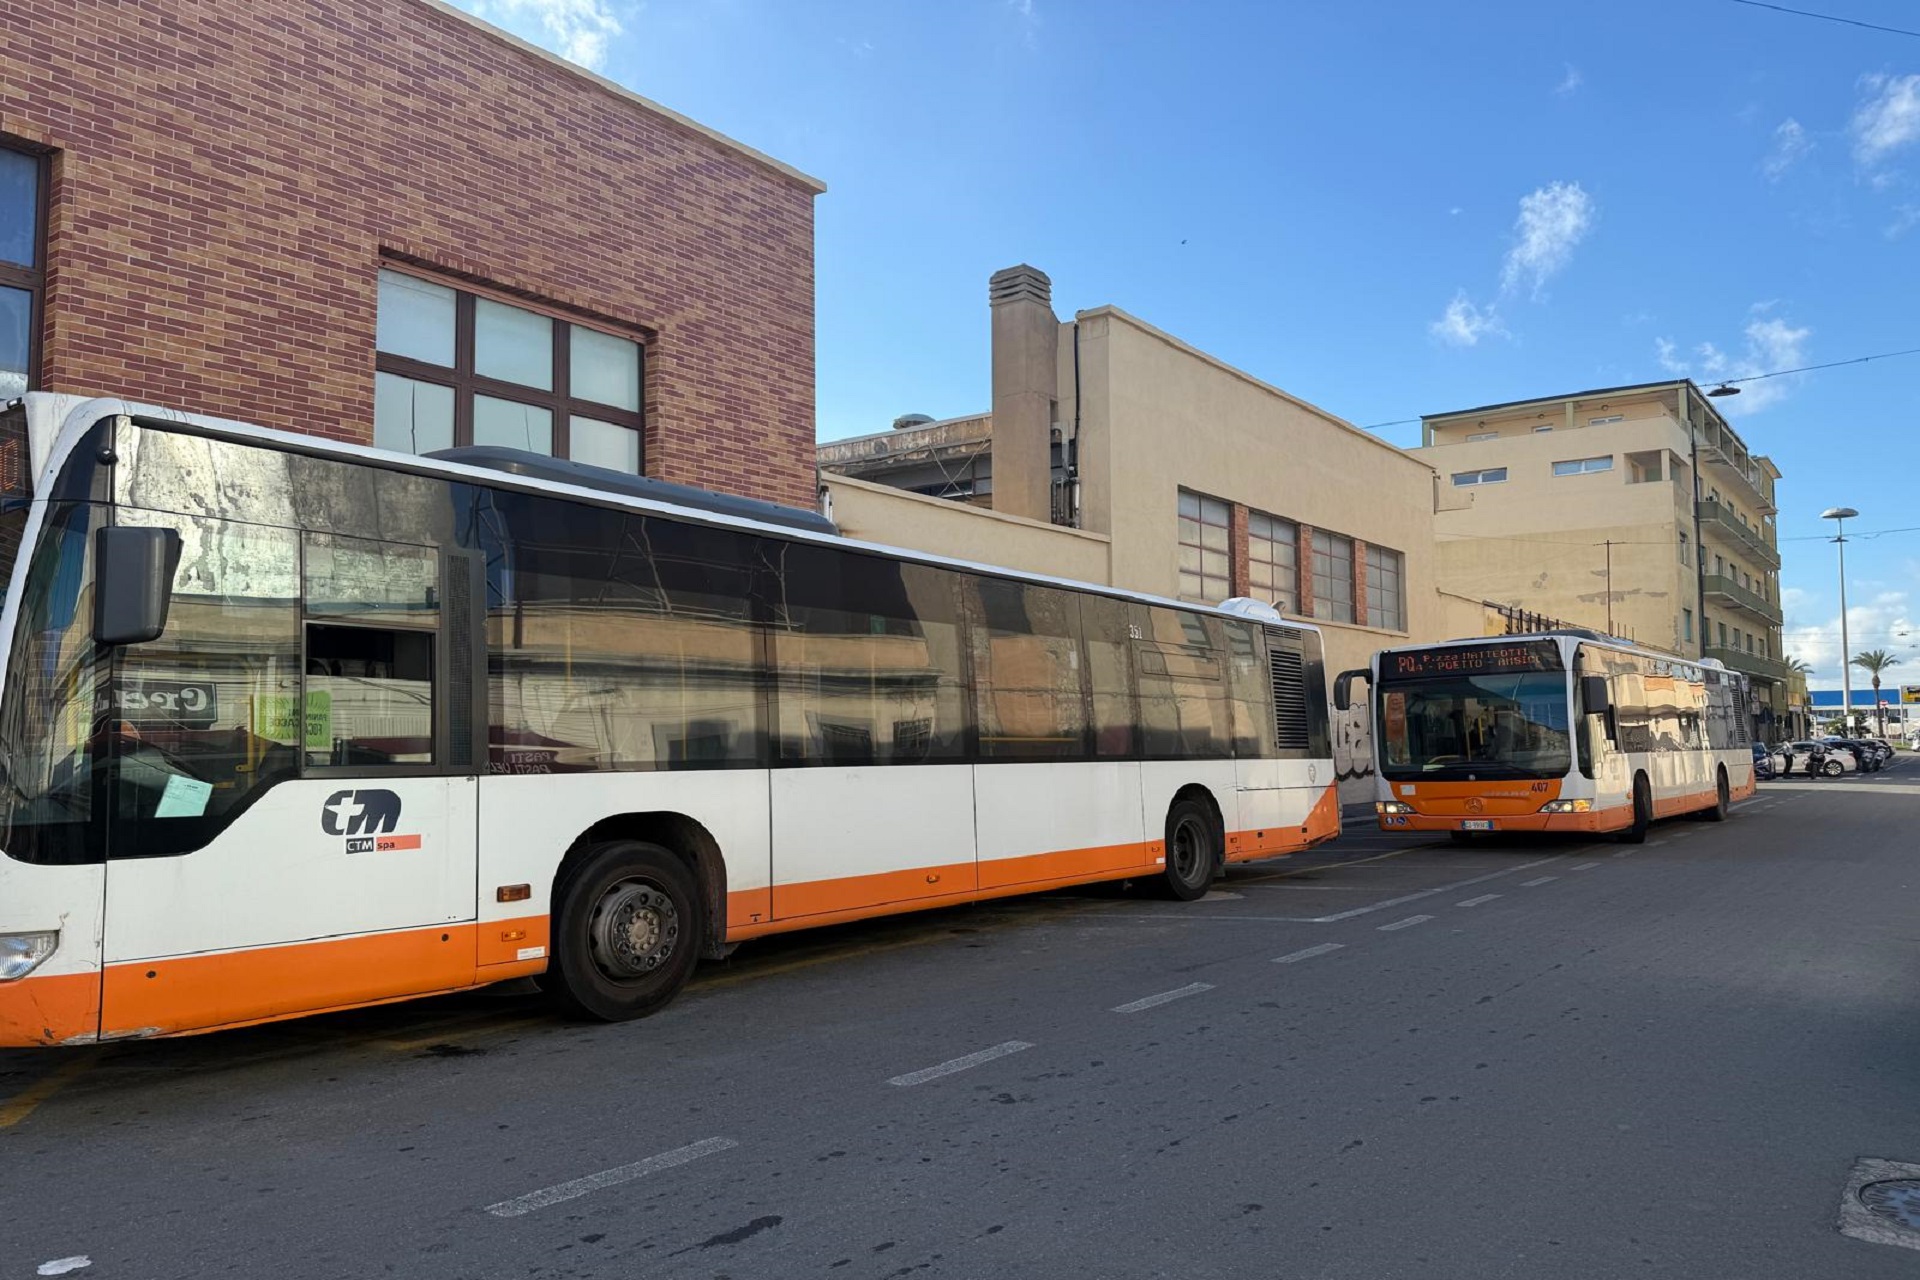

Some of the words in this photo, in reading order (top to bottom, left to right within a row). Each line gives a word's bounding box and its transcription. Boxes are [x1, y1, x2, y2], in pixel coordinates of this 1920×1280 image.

[1129, 624, 1143, 639] 351
[1462, 647, 1529, 660] MATTEOTTI
[1438, 659, 1483, 671] POETTO
[1531, 782, 1549, 792] 407
[347, 840, 373, 852] CTM
[377, 841, 396, 852] spa
